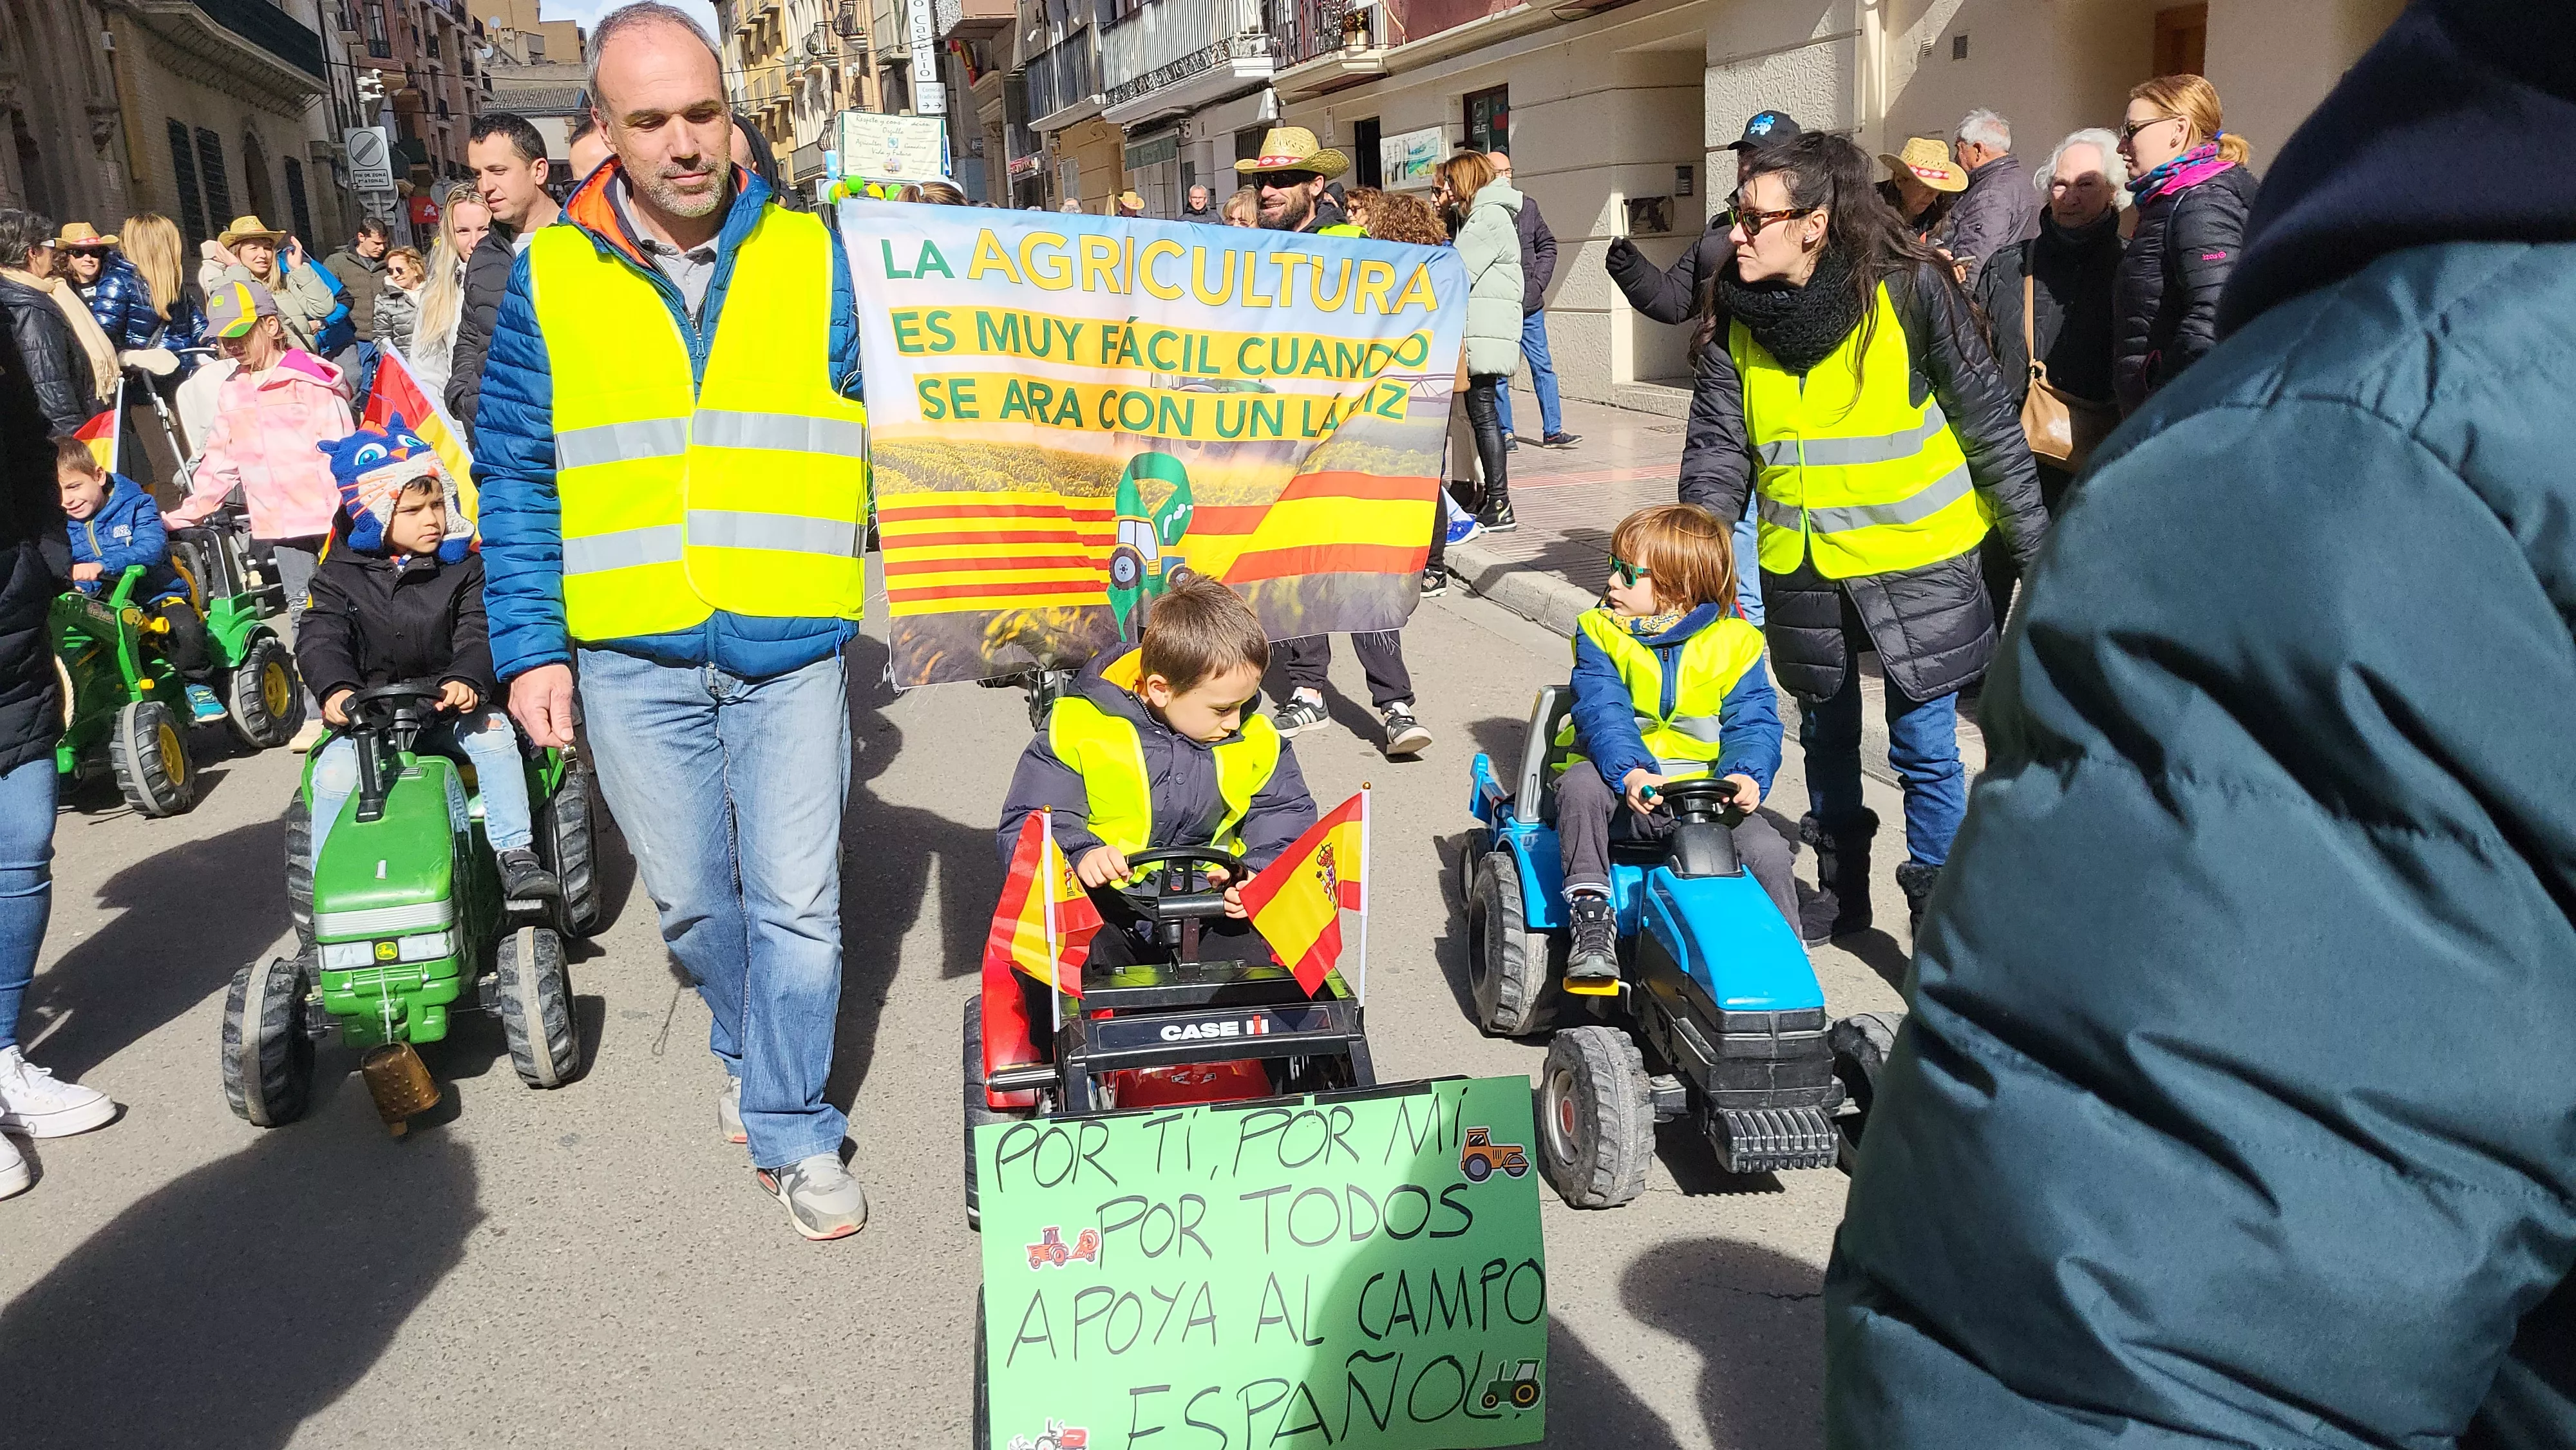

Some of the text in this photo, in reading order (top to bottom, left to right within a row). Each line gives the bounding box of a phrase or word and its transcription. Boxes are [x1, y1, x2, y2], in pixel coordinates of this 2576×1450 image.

[856, 114, 878, 125] Respeto
[882, 127, 904, 136] Orgullo
[881, 228, 1439, 314] LA AGRICULTURA
[891, 310, 1428, 379] ES MUY FÁCIL CUANDO
[918, 379, 980, 420] SE
[999, 379, 1083, 428] ARA
[1099, 390, 1194, 436] CON
[1215, 399, 1284, 438] UN
[1160, 1021, 1239, 1041] CASE
[996, 1121, 1117, 1192] POR
[1233, 1106, 1359, 1178] POR
[1385, 1086, 1469, 1166] MÍ
[1096, 1183, 1473, 1270] POR TODOS
[1007, 1257, 1547, 1368] APOYA AL CAMPO
